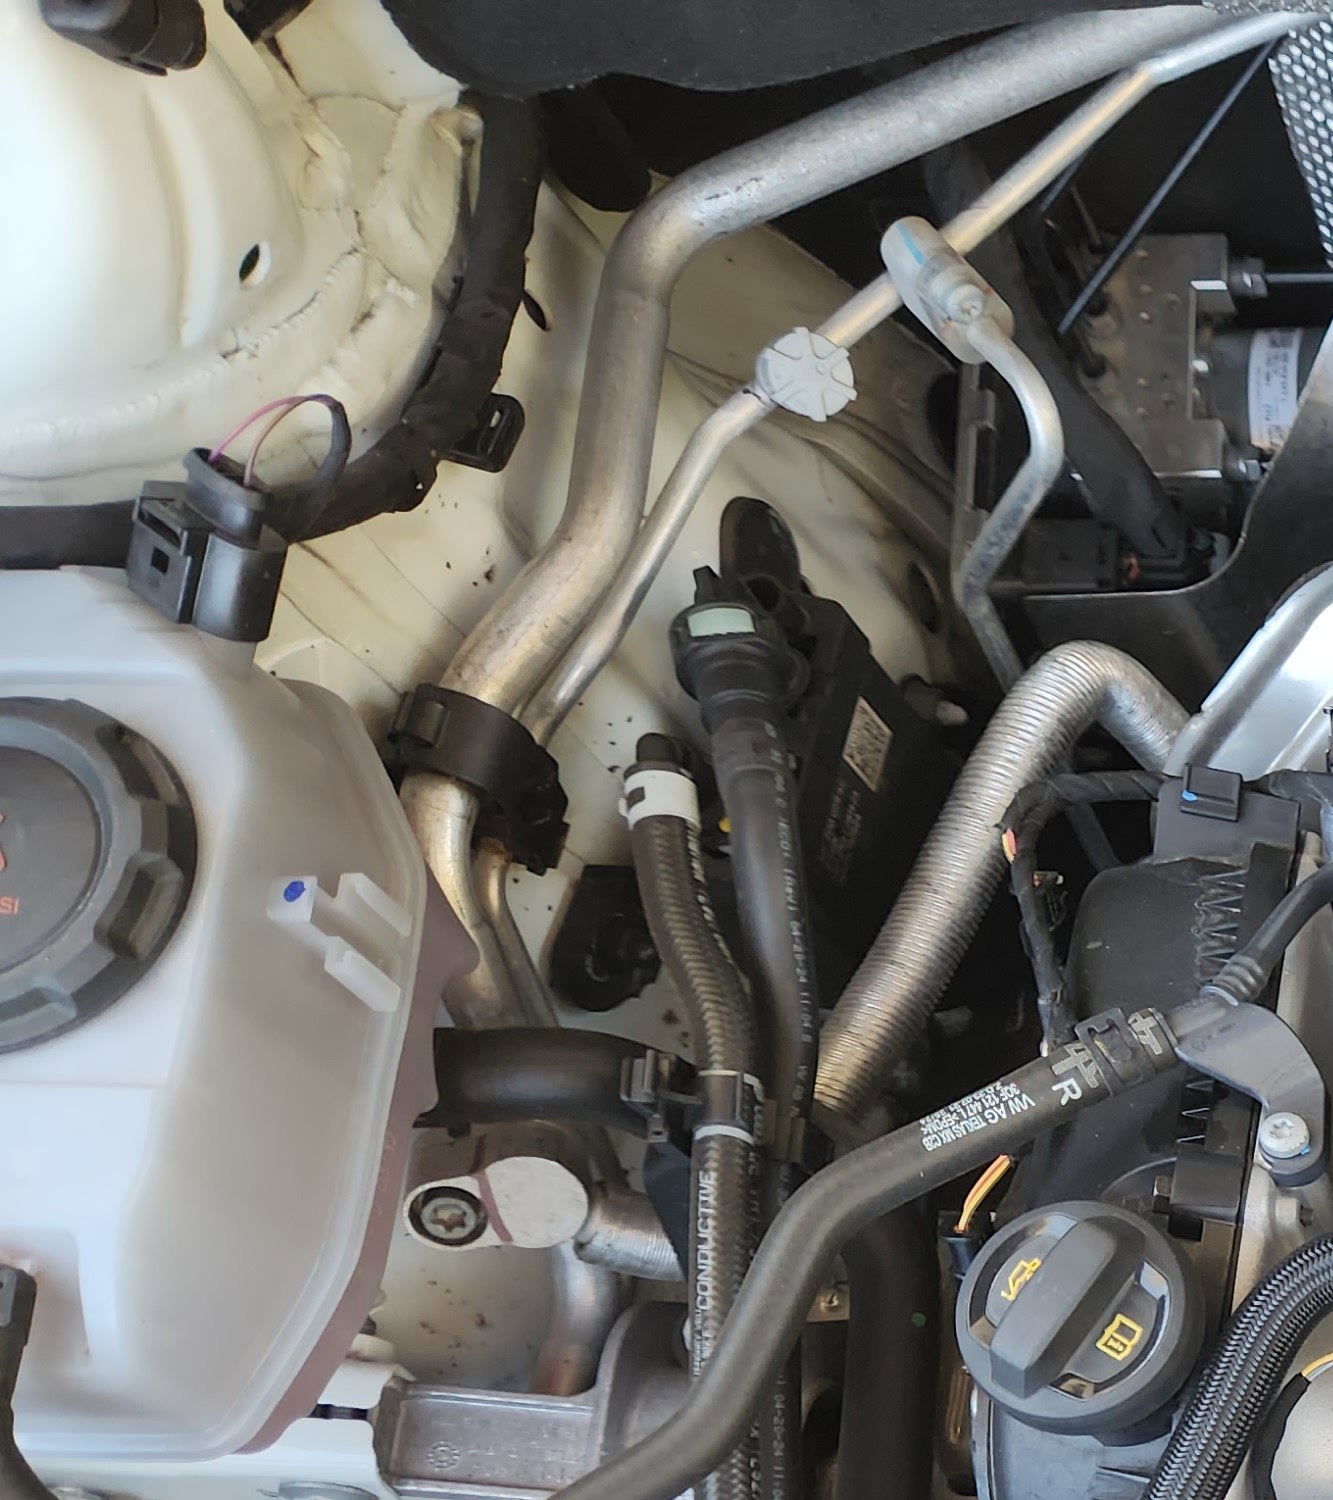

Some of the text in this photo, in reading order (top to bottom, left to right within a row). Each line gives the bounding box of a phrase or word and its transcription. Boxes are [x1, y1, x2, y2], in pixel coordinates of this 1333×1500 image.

[1006, 1090, 1035, 1115] VW
[1052, 1080, 1082, 1107] R
[982, 1102, 1009, 1125] AG
[696, 1170, 716, 1310] CONDUCTIVE
